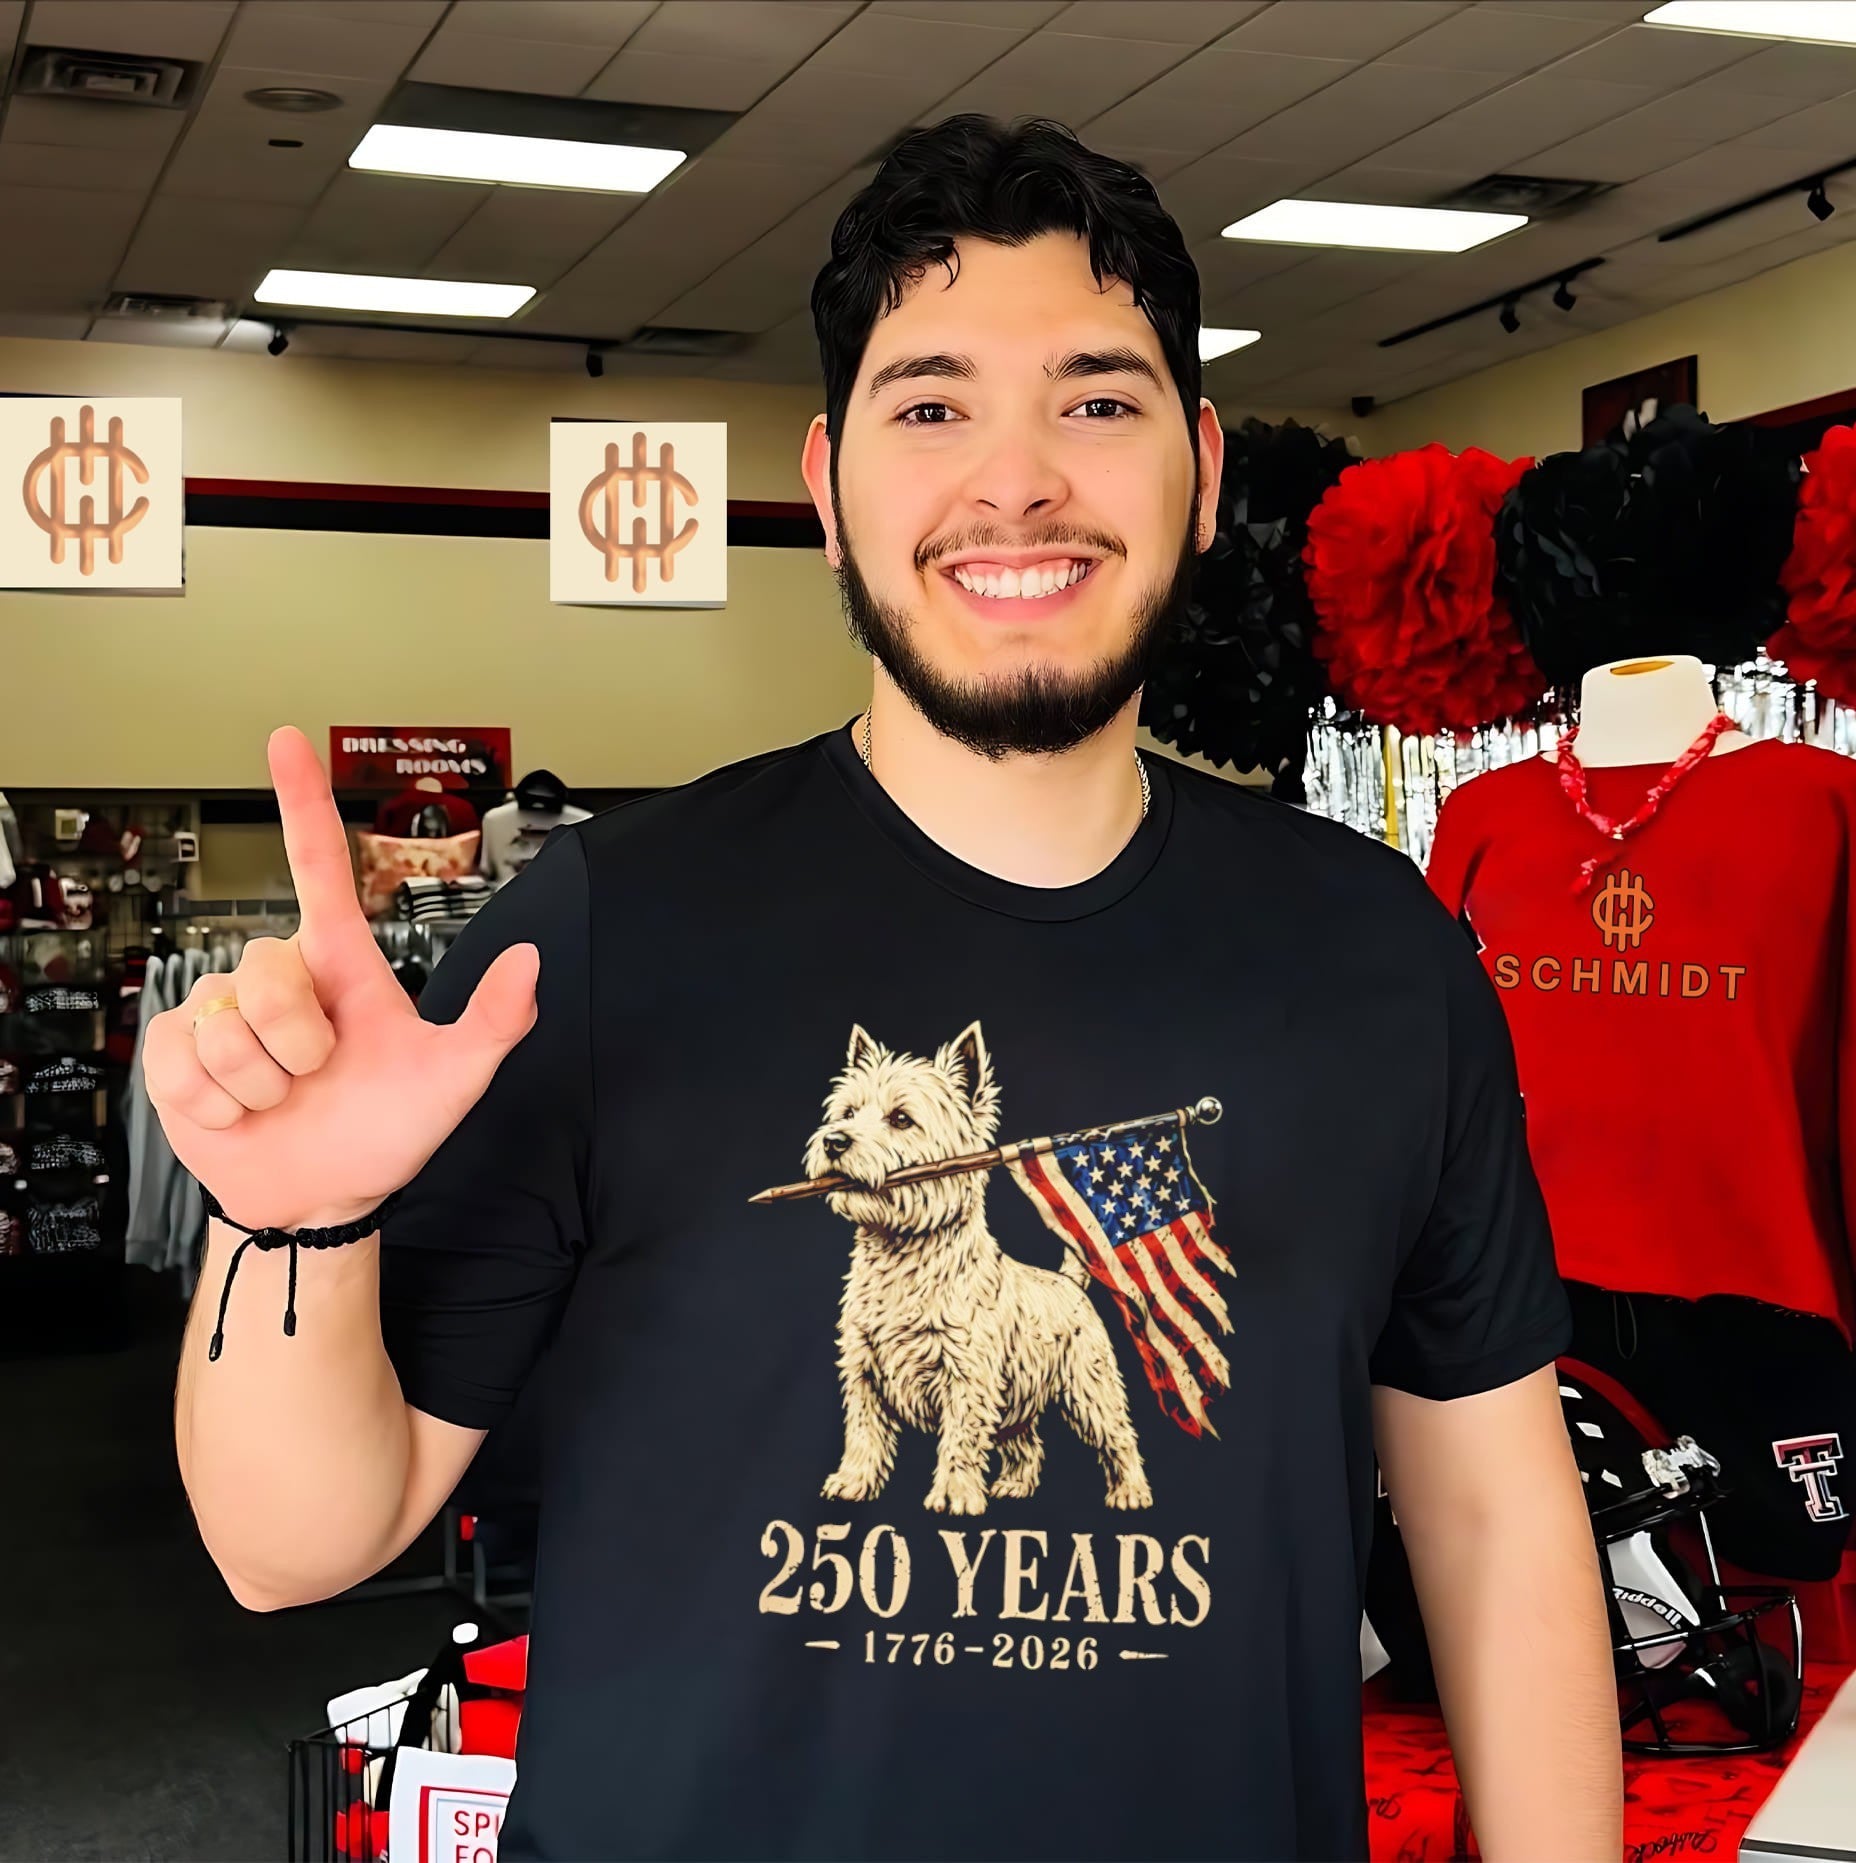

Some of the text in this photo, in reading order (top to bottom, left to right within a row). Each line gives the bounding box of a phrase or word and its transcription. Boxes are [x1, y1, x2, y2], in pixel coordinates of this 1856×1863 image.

[342, 737, 466, 754] DRESSING
[396, 758, 487, 775] ROOMS
[1494, 954, 1747, 1000] SCHMIDT
[758, 1519, 1211, 1627] 250 YEARS
[863, 1630, 1100, 1670] 1776-2026
